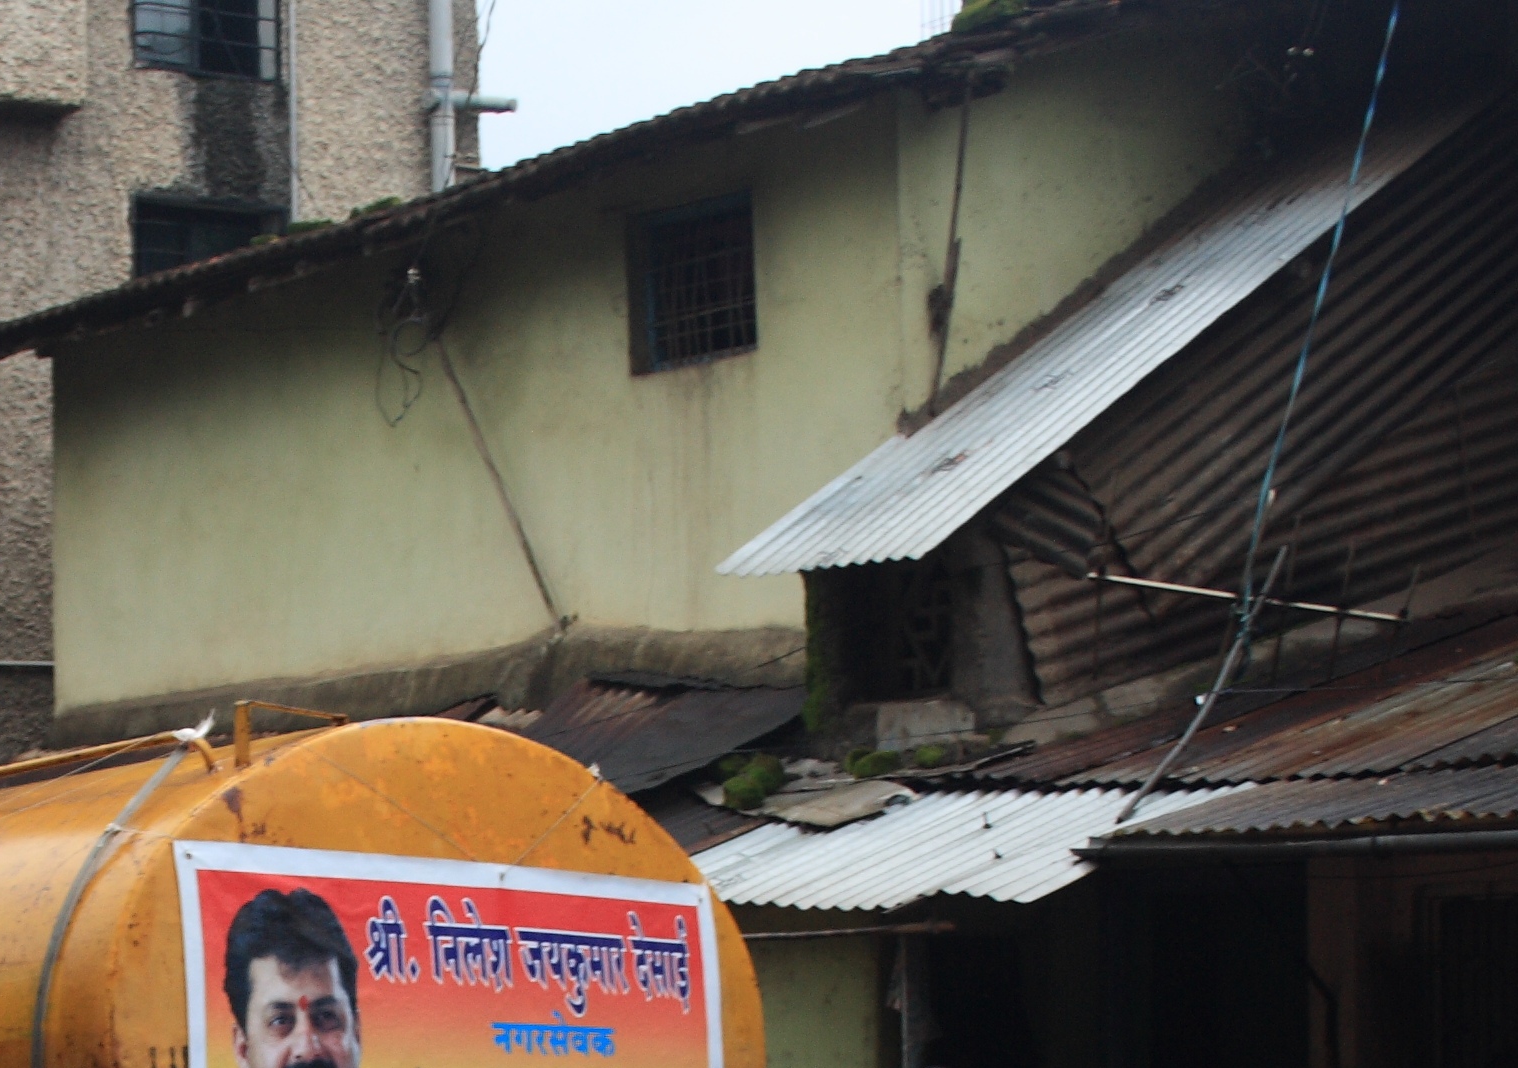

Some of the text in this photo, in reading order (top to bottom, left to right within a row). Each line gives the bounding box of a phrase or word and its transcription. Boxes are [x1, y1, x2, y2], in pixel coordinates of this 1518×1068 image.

[363, 895, 690, 1018] श्री. निलेश जयकुमार देसाई
[491, 1010, 616, 1057] नगरसेवक
